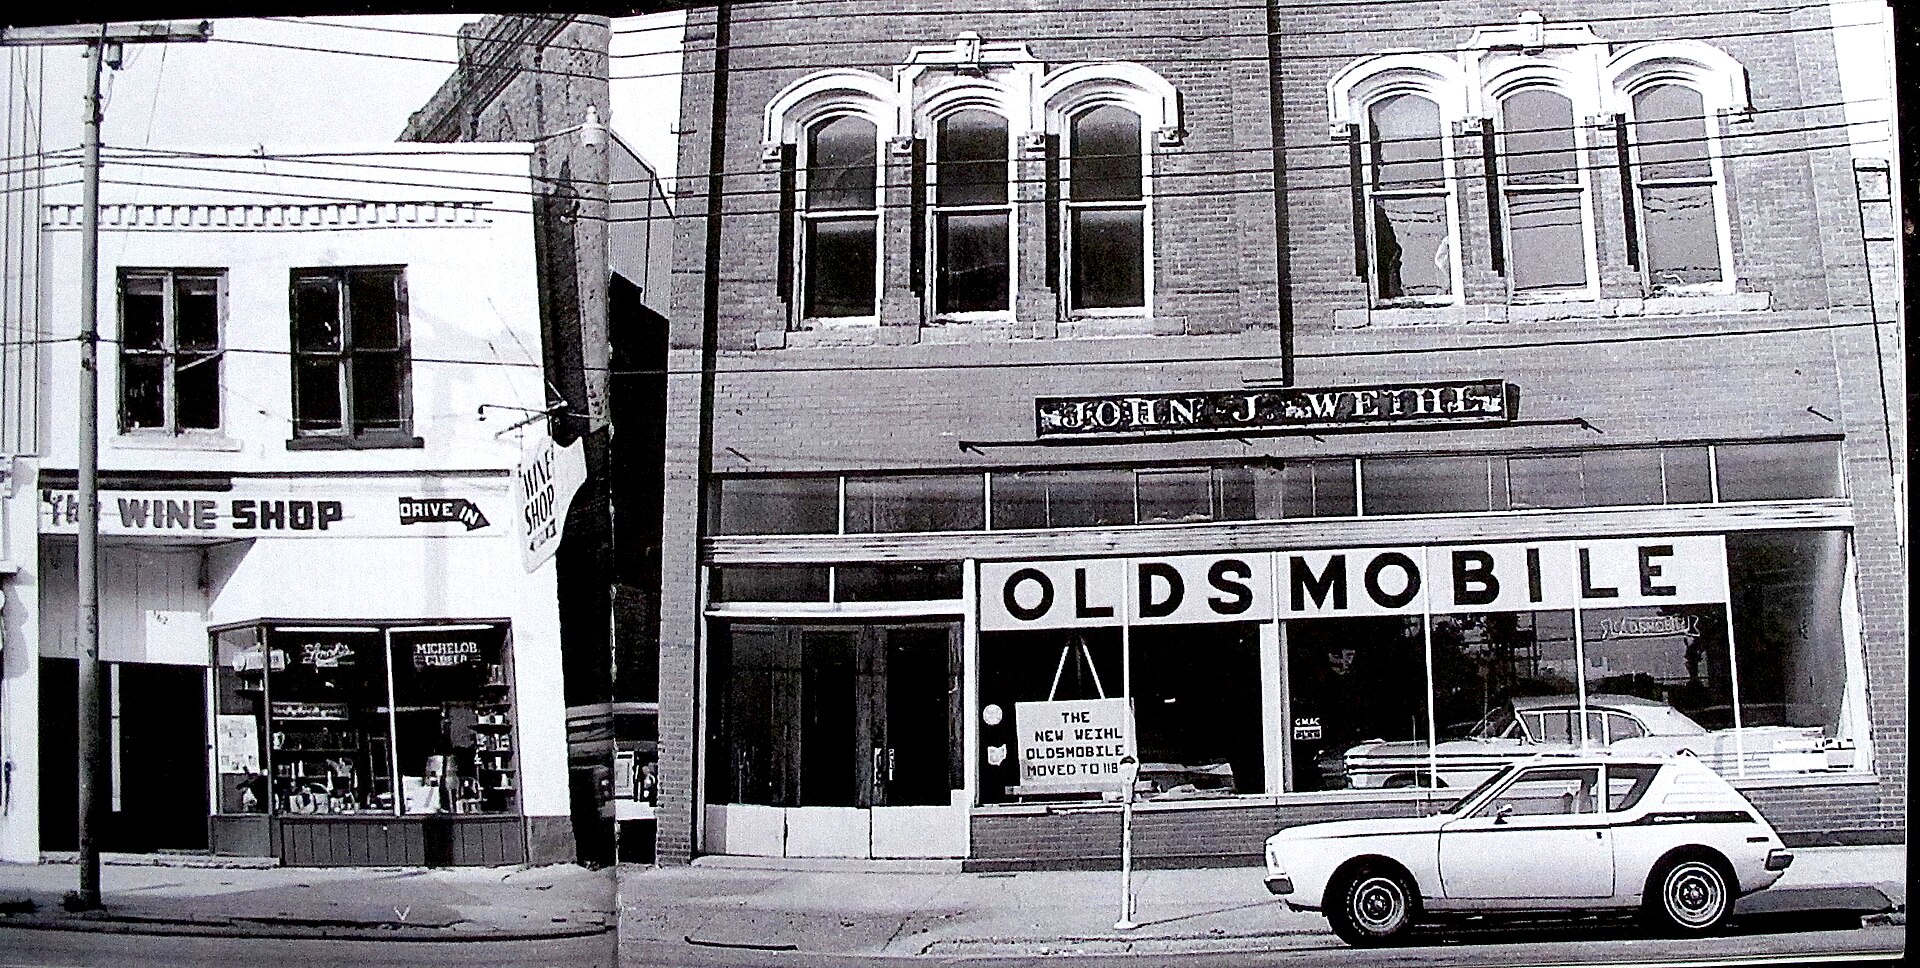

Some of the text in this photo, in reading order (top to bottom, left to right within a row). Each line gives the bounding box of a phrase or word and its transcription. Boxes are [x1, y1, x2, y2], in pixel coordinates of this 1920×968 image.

[1062, 398, 1201, 428] JOHN
[1301, 386, 1483, 418] WEIHL
[117, 498, 217, 529] WINE
[231, 500, 343, 530] SHOP
[400, 502, 480, 526] DRIVE IN
[524, 484, 554, 535] SHOP
[1003, 545, 1677, 621] OLDSMOBILE
[415, 642, 478, 654] MICHELOB
[1061, 711, 1090, 724] THE
[1034, 727, 1123, 742] NEW WEIHL
[1026, 745, 1124, 760] OLDSMOBILE
[1027, 762, 1118, 777] MOVED TO 118
